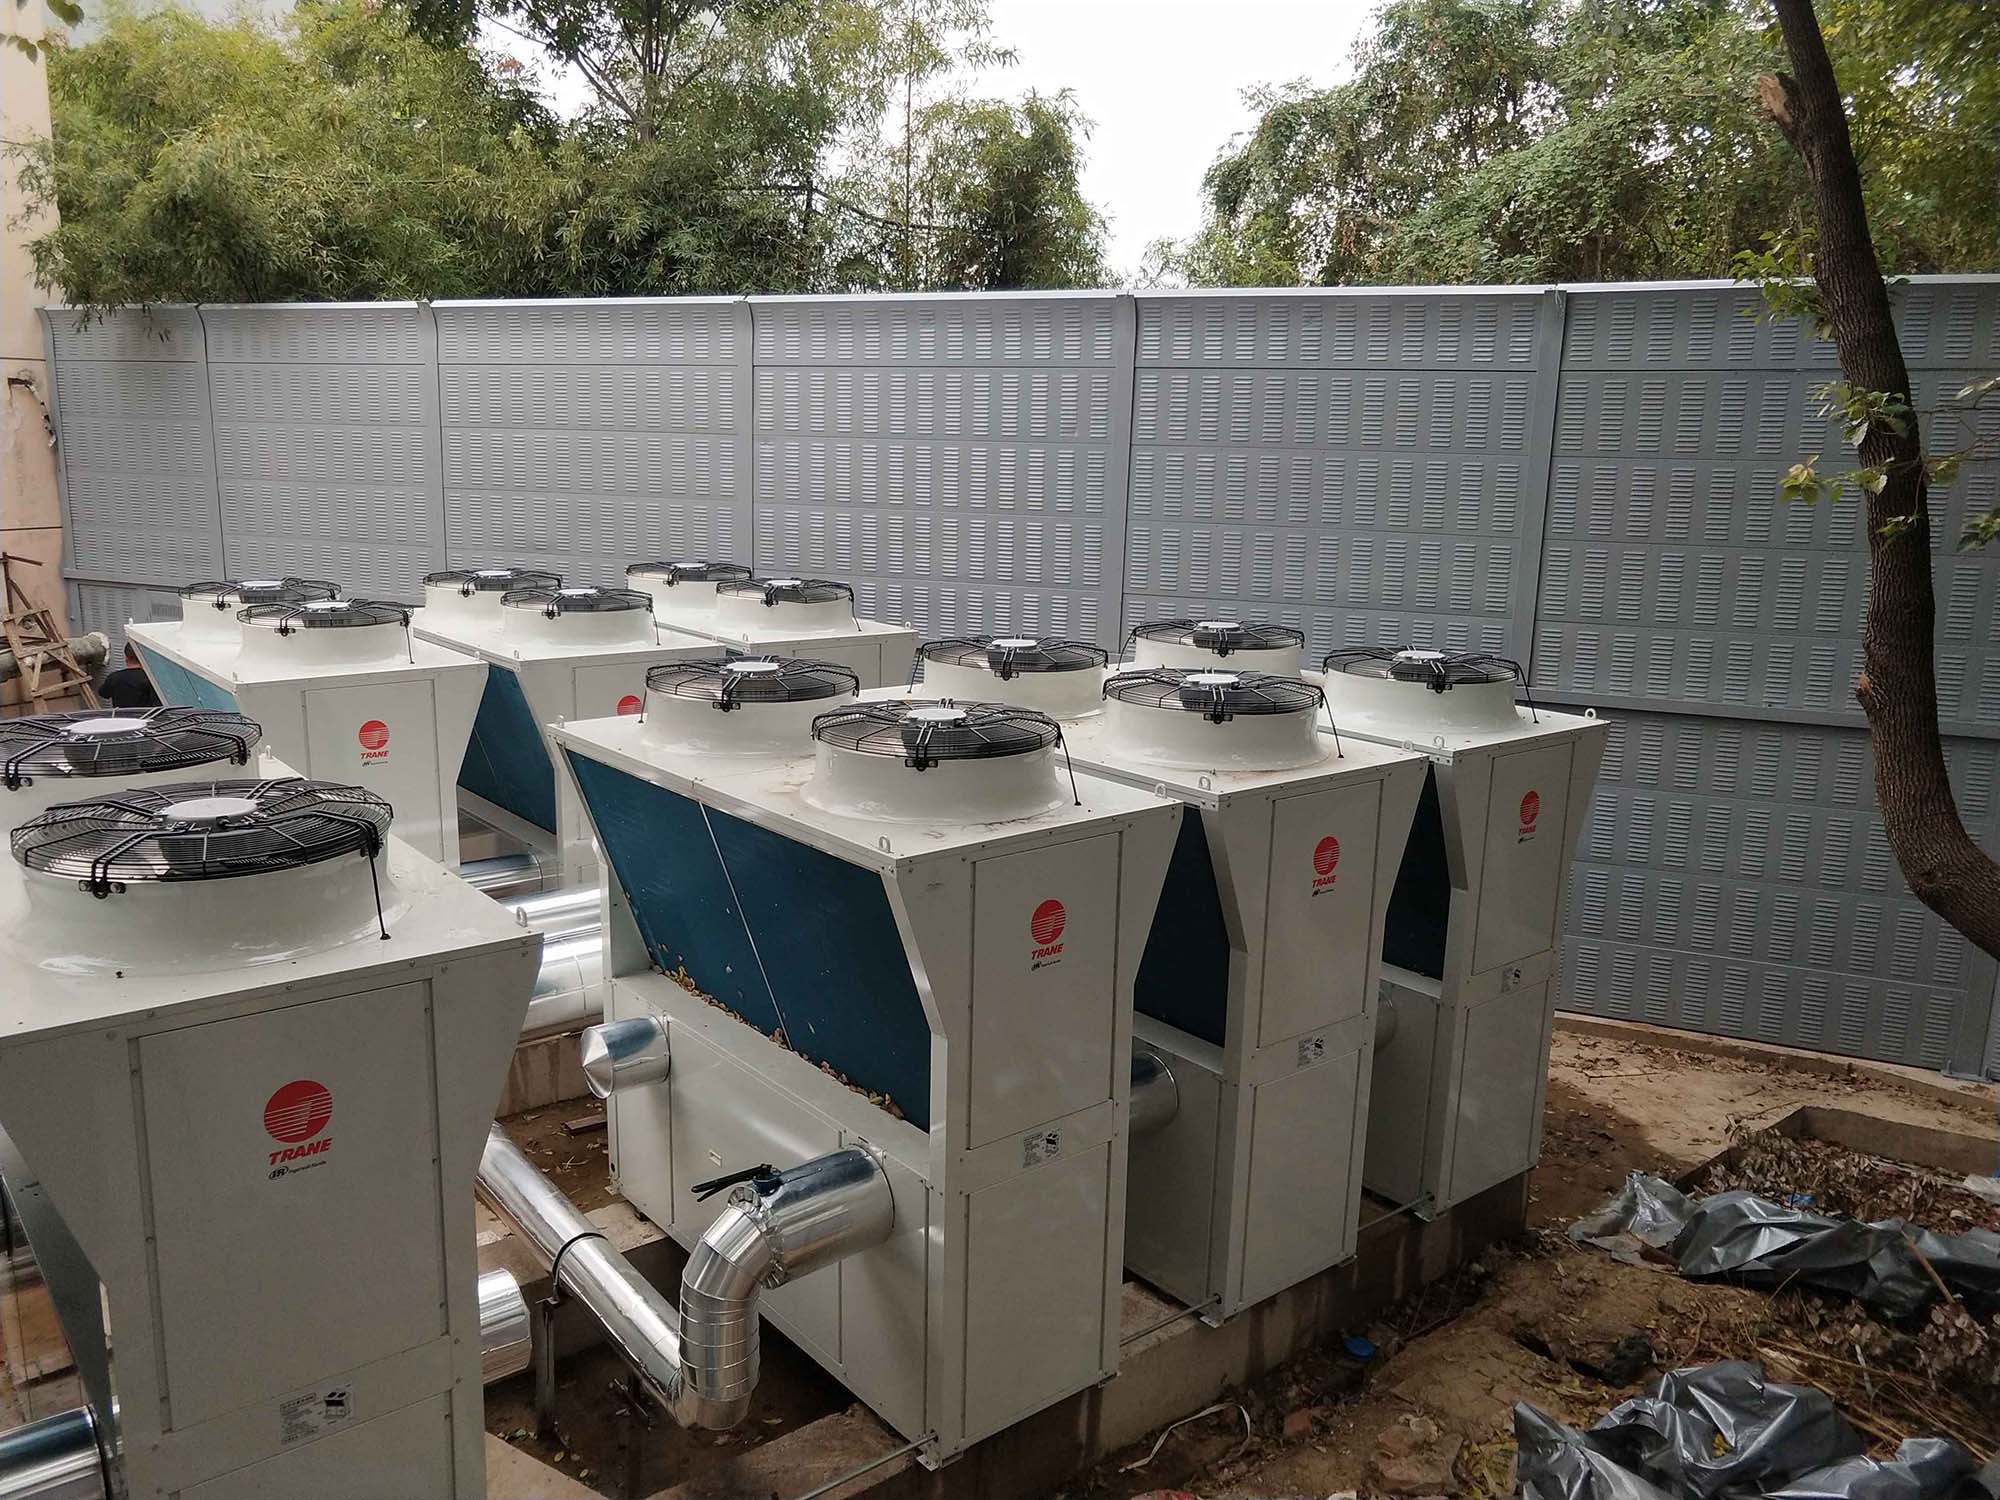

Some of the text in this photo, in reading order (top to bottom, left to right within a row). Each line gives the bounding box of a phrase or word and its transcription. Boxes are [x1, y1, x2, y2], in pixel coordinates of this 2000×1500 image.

[361, 751, 389, 760] TRANE
[1031, 943, 1064, 960] TRANE
[269, 1137, 333, 1166] TRANE
